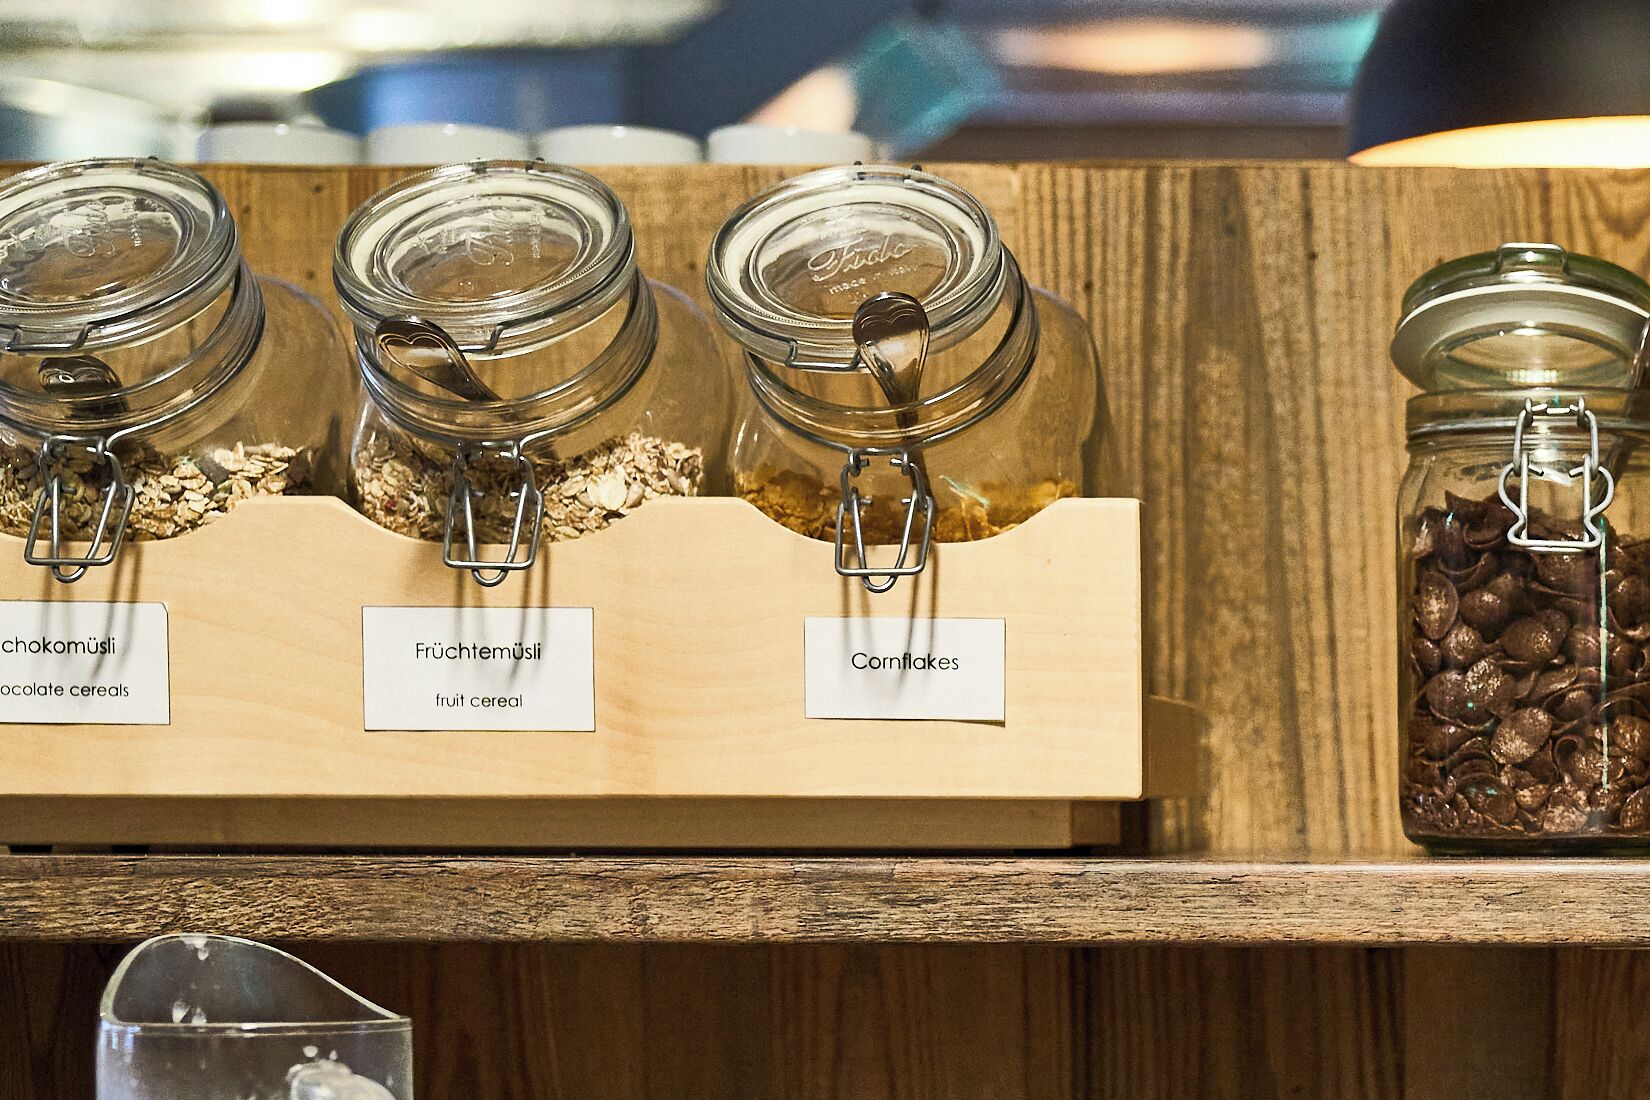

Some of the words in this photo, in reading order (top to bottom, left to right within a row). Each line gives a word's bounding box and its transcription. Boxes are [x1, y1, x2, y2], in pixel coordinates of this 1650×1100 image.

[416, 643, 542, 660] Früchtemüsli
[851, 652, 960, 671] Cornflakes
[69, 683, 130, 697] cereals
[436, 693, 464, 707] fruit
[470, 694, 523, 708] cereal
